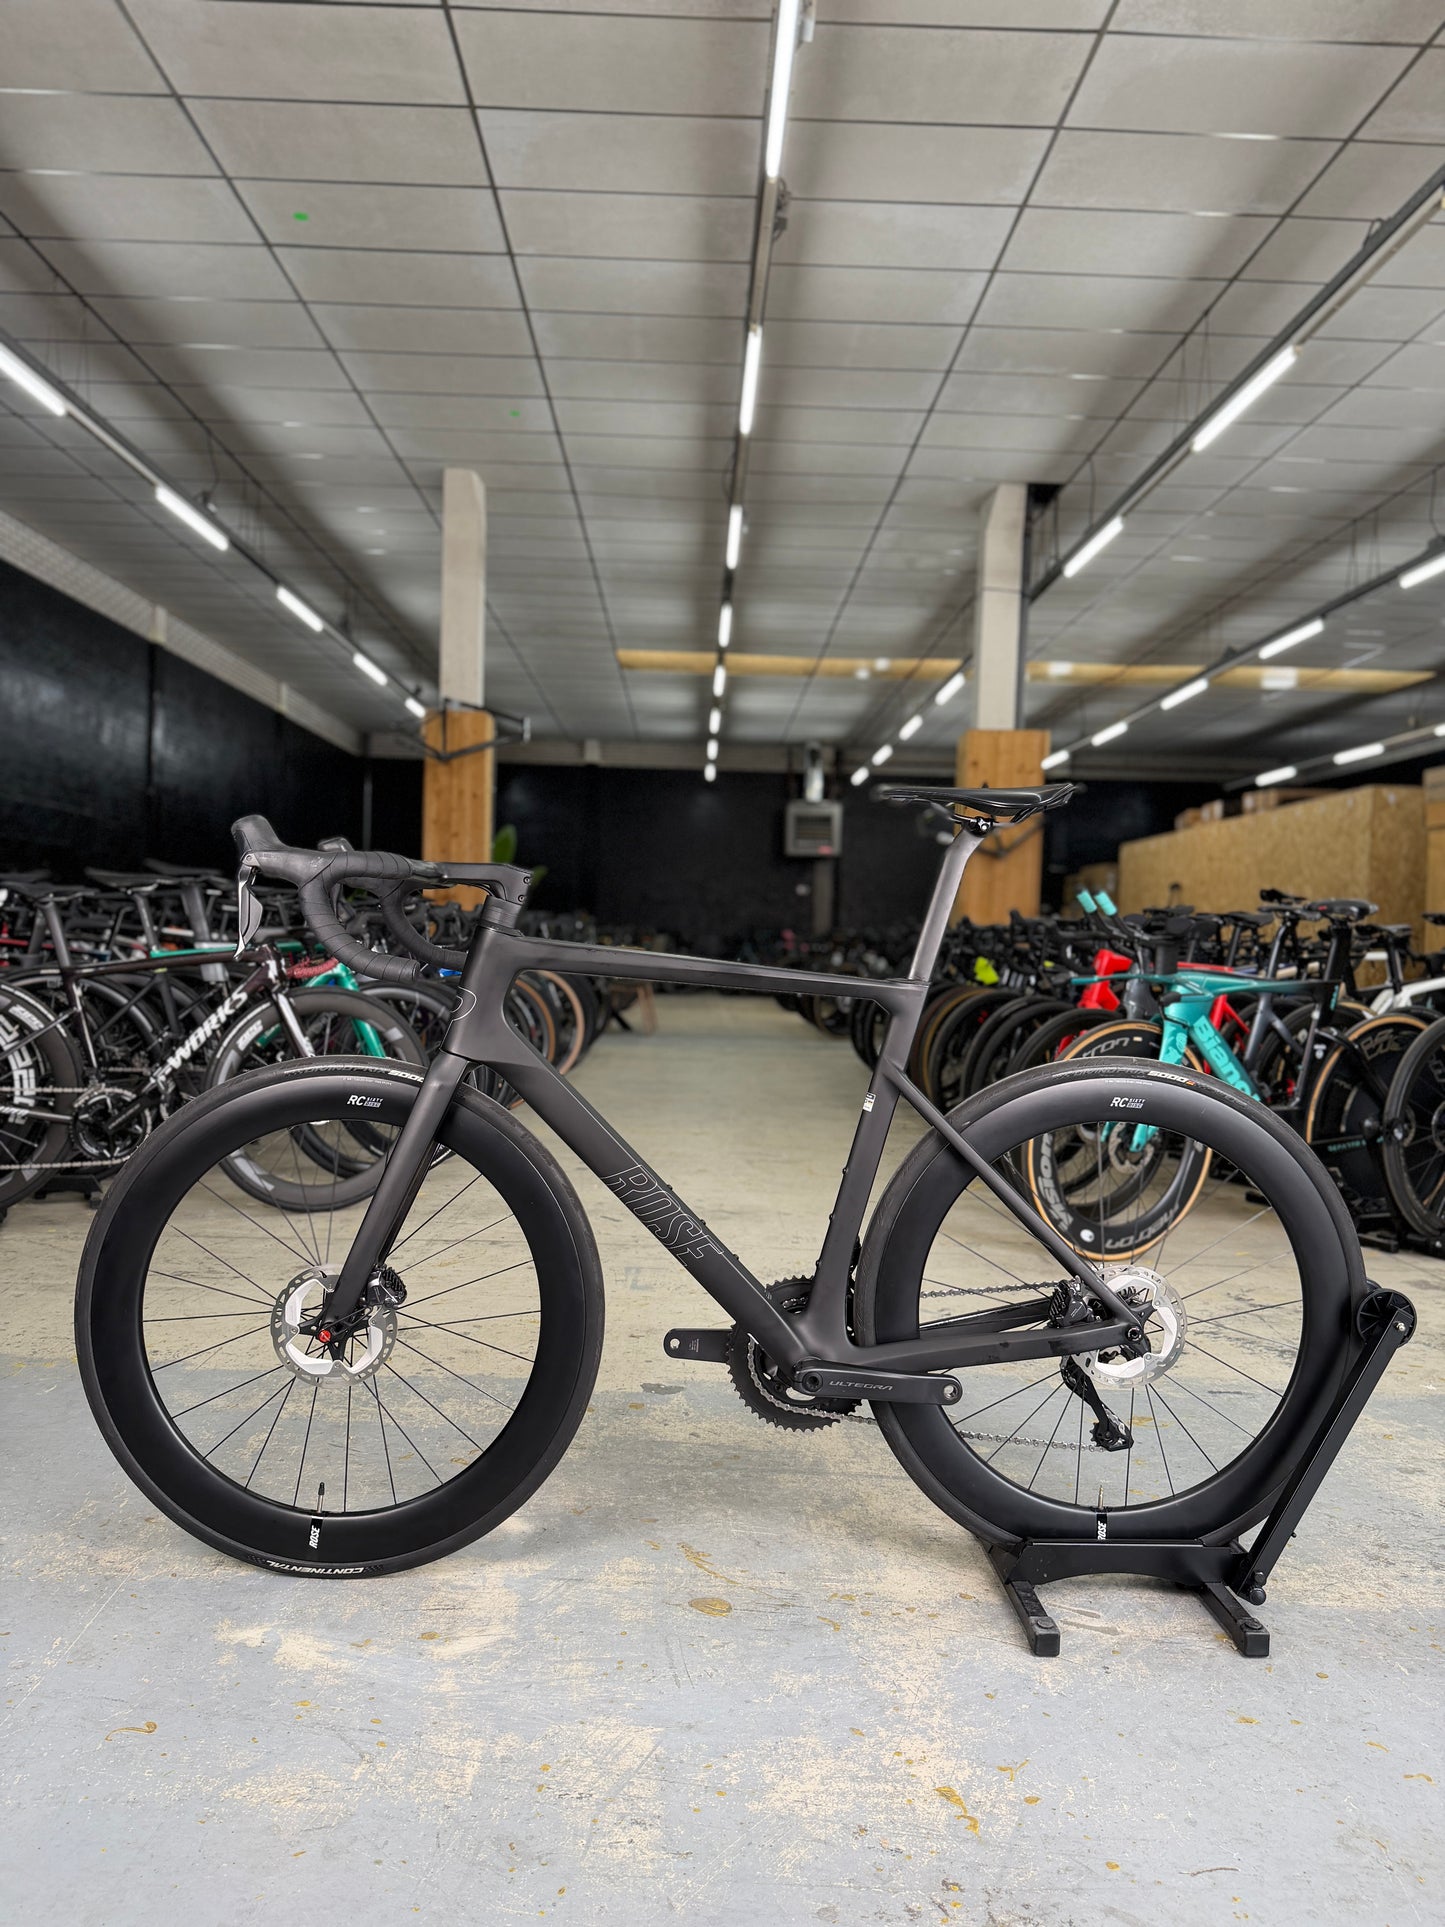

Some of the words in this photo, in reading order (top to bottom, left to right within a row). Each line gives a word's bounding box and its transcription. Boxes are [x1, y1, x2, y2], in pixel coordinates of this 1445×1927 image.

[1193, 1015, 1261, 1101] Bianc
[1148, 1070, 1188, 1083] 5000
[347, 1094, 366, 1106] RC
[1110, 1097, 1129, 1108] RC
[600, 1165, 725, 1267] ROSE
[829, 1380, 893, 1392] ULTEGRA
[308, 1525, 321, 1549] ROSE
[266, 1560, 365, 1575] CONTINENTAL
